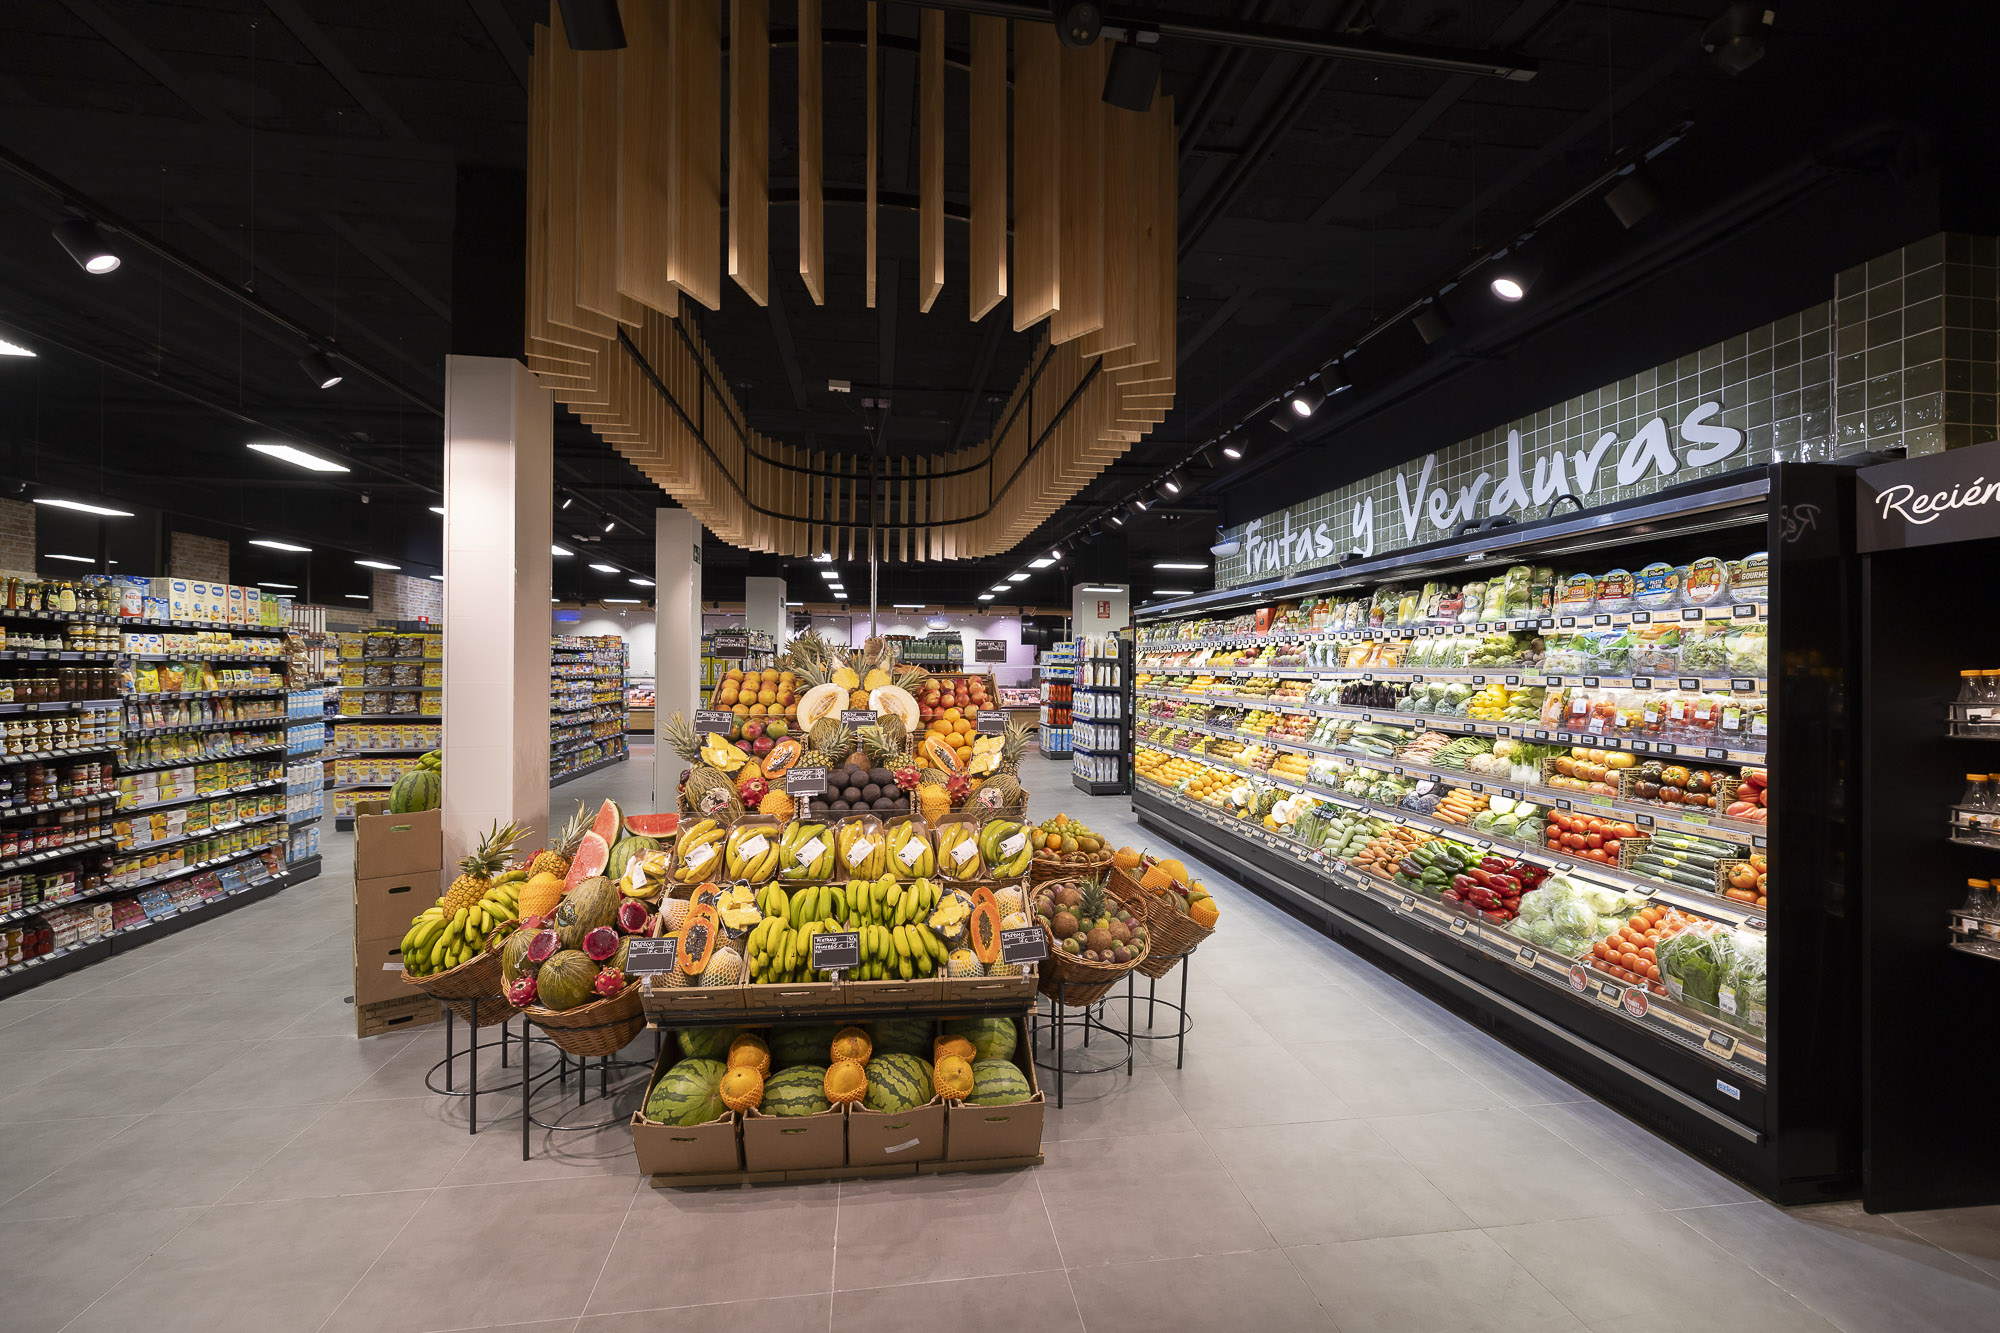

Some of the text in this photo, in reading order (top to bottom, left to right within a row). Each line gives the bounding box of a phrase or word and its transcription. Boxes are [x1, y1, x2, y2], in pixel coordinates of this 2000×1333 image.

[1244, 510, 1334, 575] Frutas
[1352, 497, 1374, 557] y
[1397, 401, 1746, 541] Verduras
[1875, 476, 2000, 524] Recién
